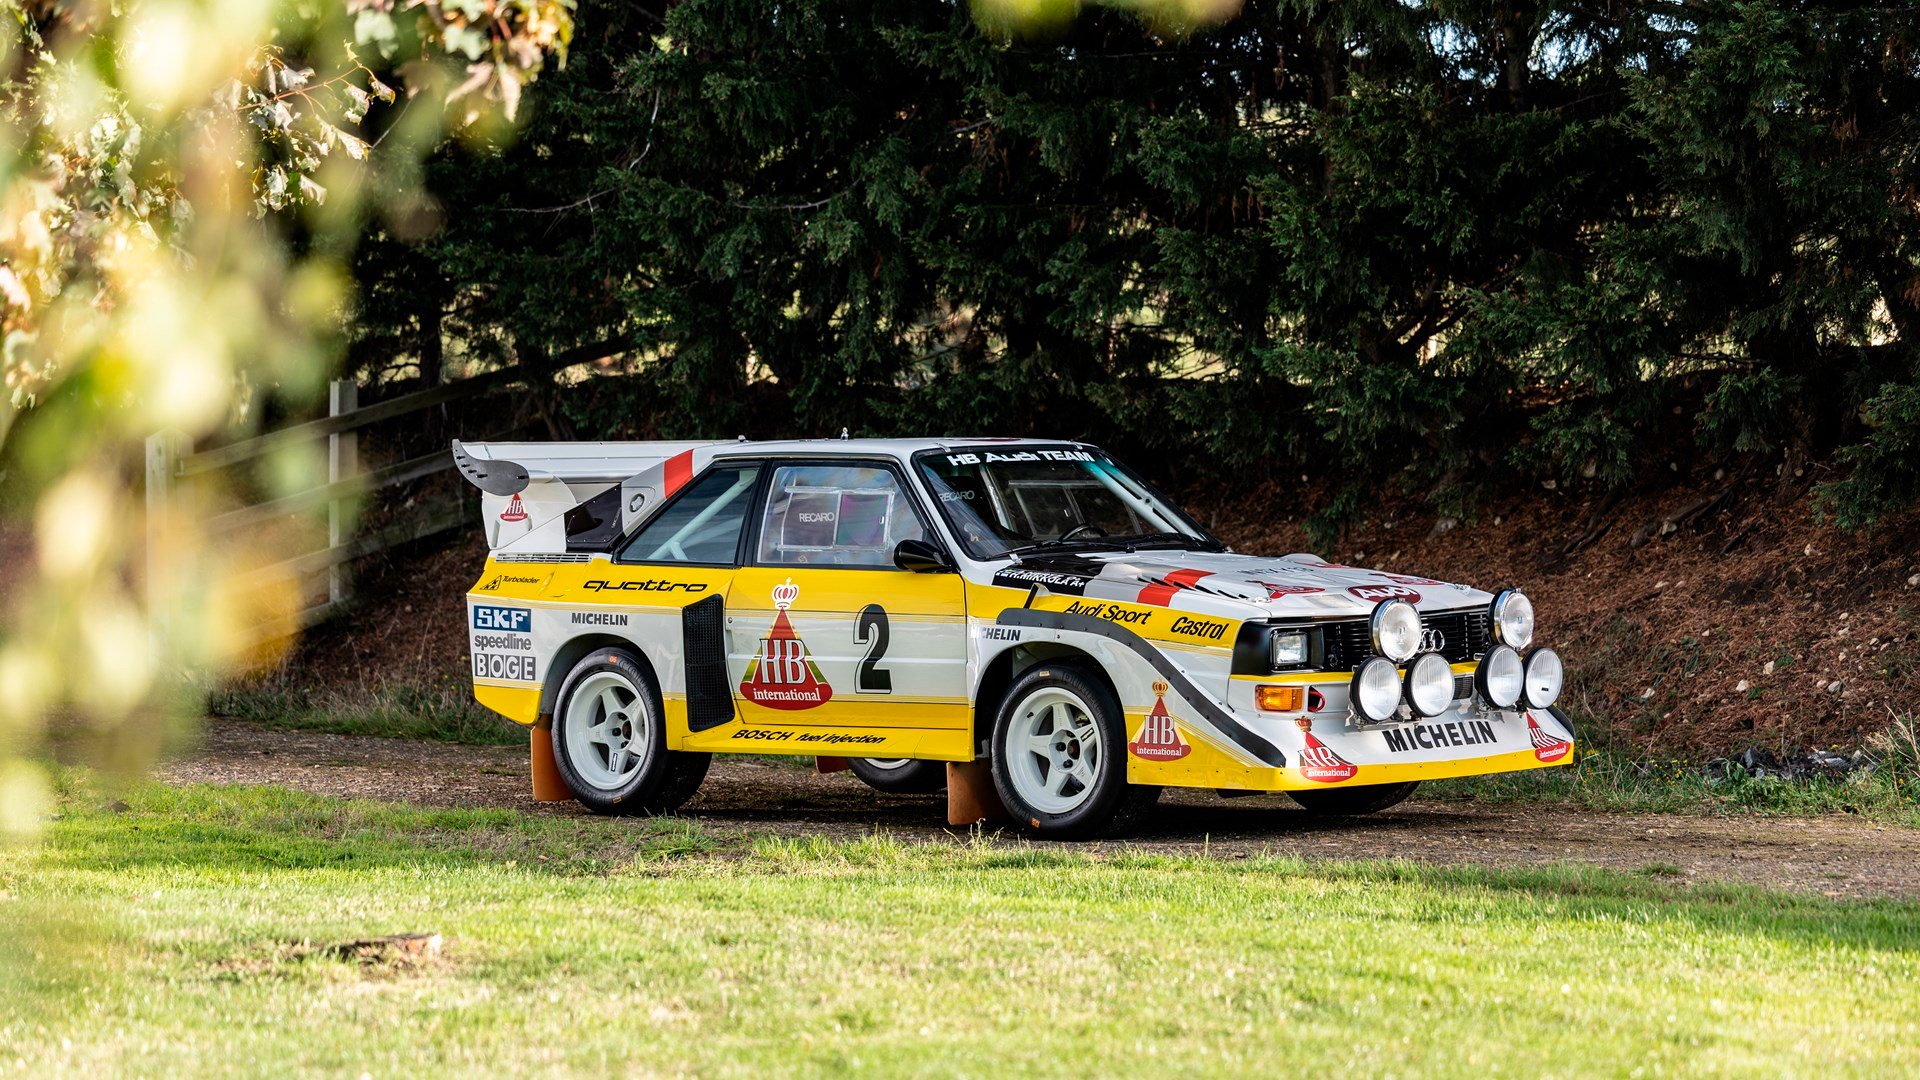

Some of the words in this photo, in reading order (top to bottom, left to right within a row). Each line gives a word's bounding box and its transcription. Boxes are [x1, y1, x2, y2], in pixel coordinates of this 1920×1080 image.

[947, 453, 981, 466] HB
[1038, 450, 1095, 462] TEAM
[939, 491, 975, 502] RECARO
[506, 500, 523, 514] HB
[799, 512, 835, 522] RECARO
[502, 575, 540, 584] Turbolader
[583, 580, 708, 592] quattro
[477, 608, 529, 629] SKF
[571, 612, 628, 626] MICHELIN
[1064, 601, 1107, 617] Audi
[1103, 605, 1152, 625] Sport
[1170, 616, 1229, 640] Castrol
[474, 633, 532, 651] speedline
[853, 603, 893, 694] 2
[476, 654, 534, 680] BOGE
[759, 639, 807, 684] HB
[753, 687, 821, 701] international
[731, 729, 795, 741] BOSCH
[795, 732, 829, 742] fuel
[823, 733, 887, 744] injection
[1144, 715, 1175, 745] HB
[1382, 721, 1497, 752] MICHELIN
[1136, 746, 1183, 756] international
[1298, 746, 1341, 767] HB
[1539, 744, 1567, 759] international
[1306, 767, 1352, 777] international
